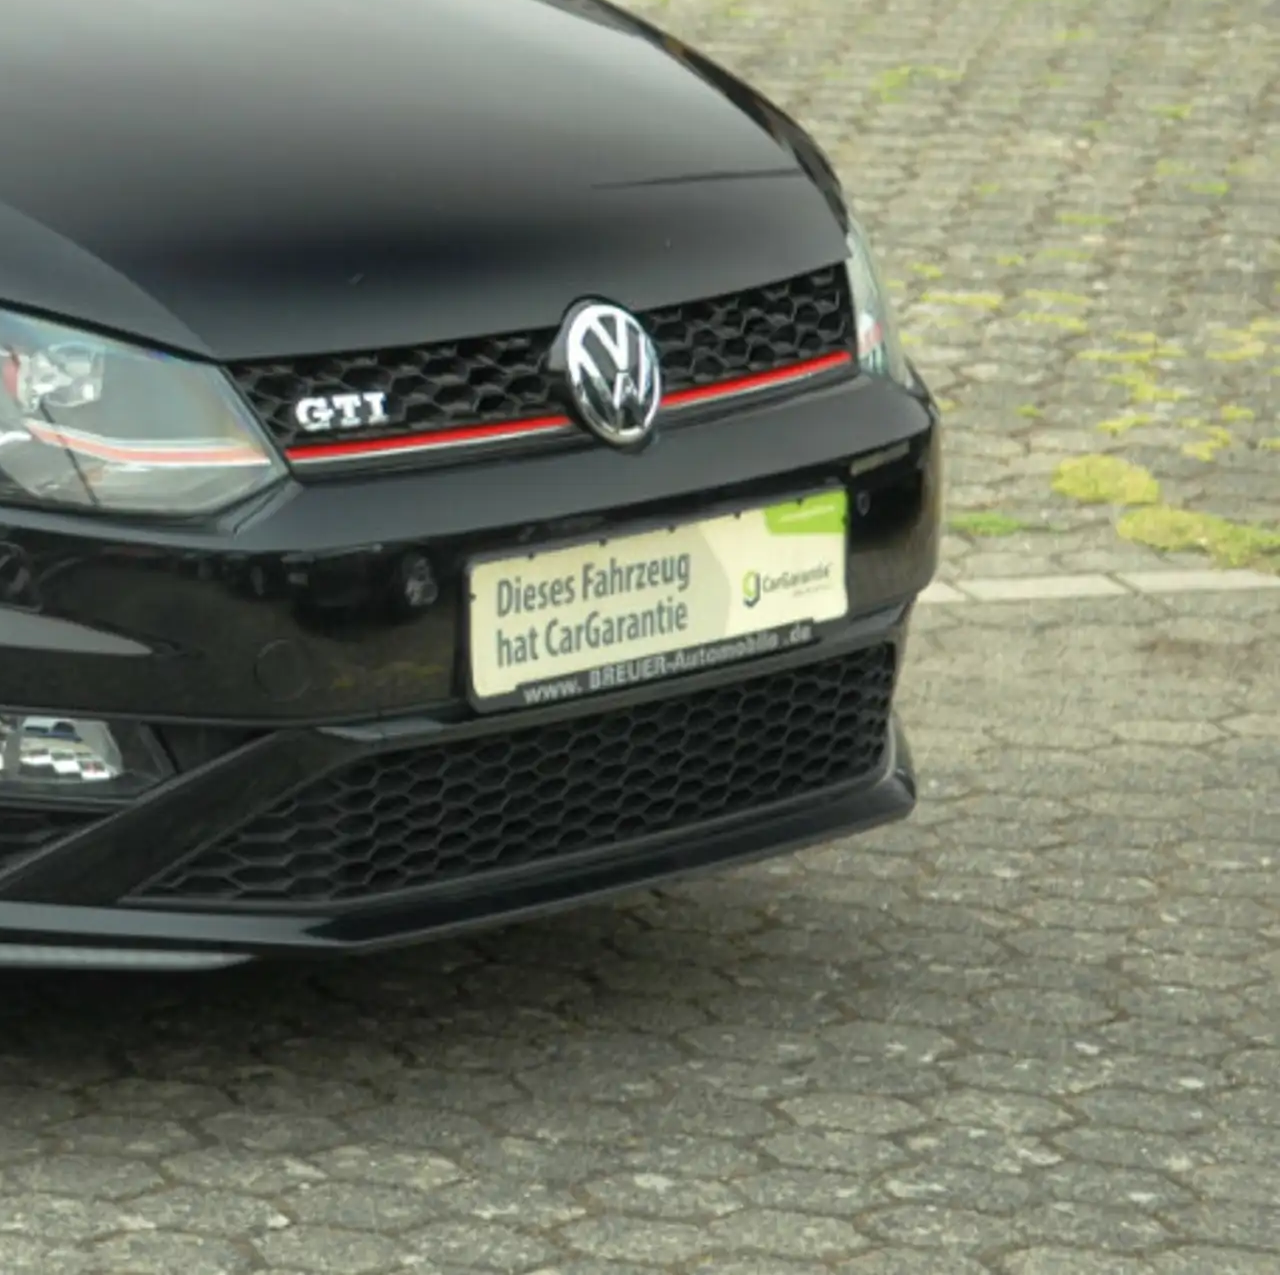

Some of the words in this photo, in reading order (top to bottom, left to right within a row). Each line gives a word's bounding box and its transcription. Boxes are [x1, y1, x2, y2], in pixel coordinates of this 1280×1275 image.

[295, 391, 390, 432] GTI
[497, 576, 576, 617] Dieses
[582, 553, 691, 602] Fahrzeug
[497, 627, 539, 668] hat
[545, 596, 689, 657] CarGarantie
